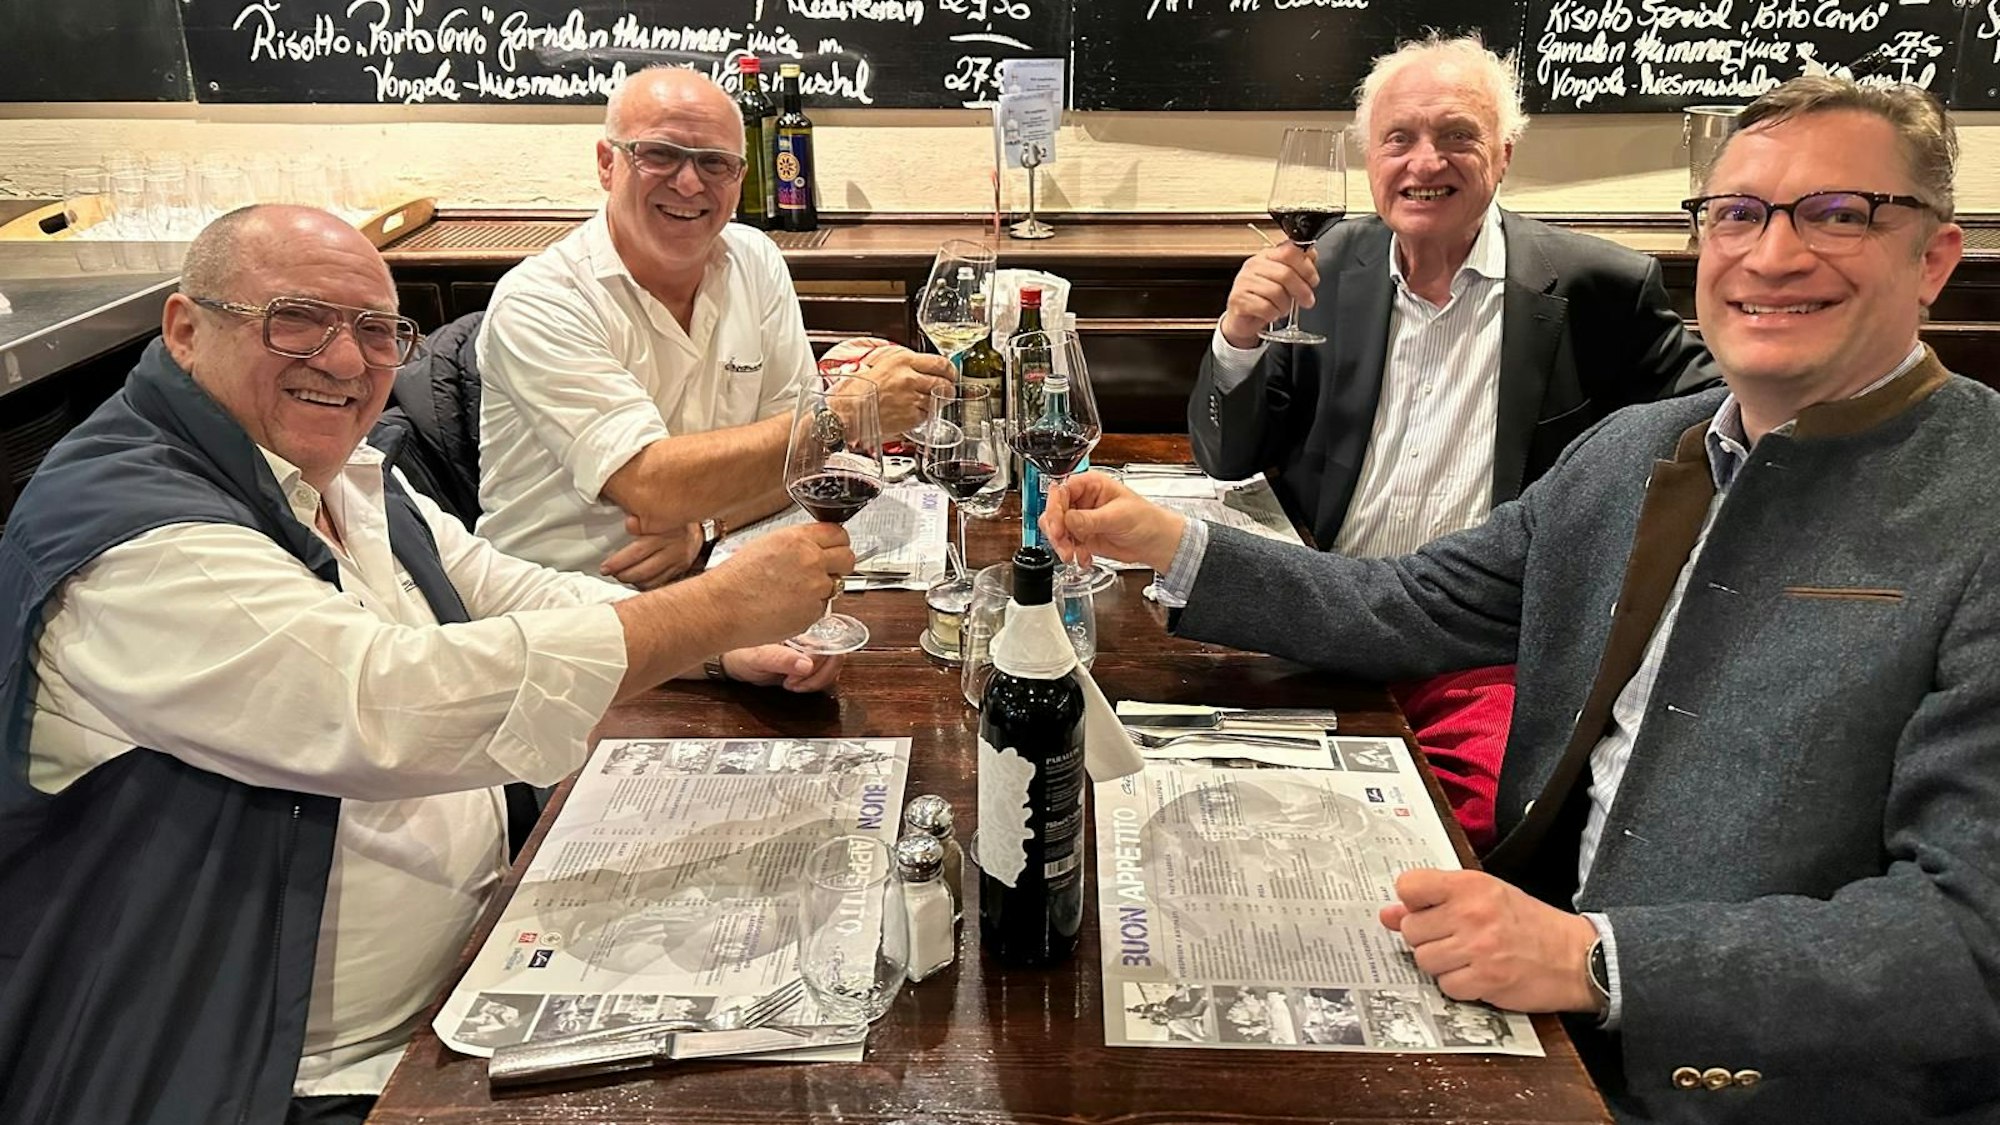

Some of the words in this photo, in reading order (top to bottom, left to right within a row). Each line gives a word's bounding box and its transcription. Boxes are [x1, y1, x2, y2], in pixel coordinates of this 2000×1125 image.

[233, 4, 351, 62] Risotto
[857, 784, 887, 829] BUON
[1111, 808, 1146, 902] APPETITO
[838, 838, 876, 937] APPETITO
[1118, 906, 1151, 968] BUON
